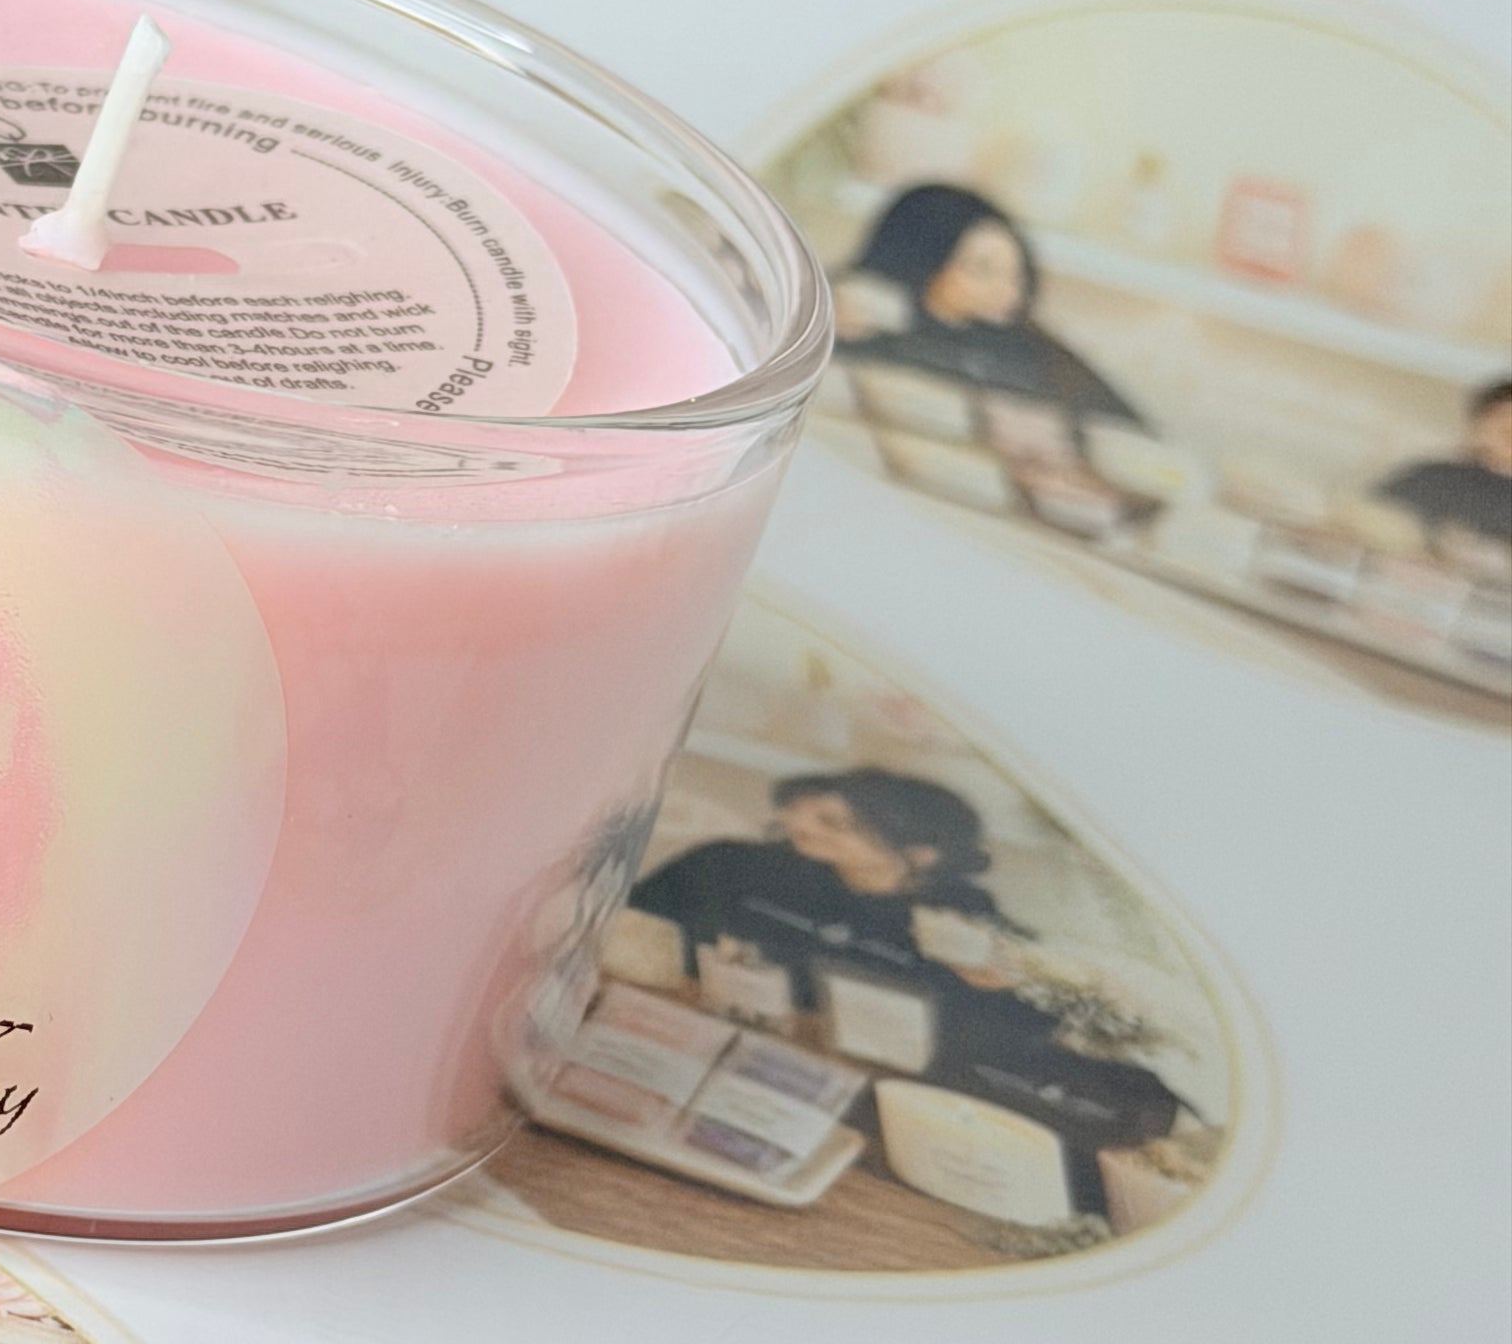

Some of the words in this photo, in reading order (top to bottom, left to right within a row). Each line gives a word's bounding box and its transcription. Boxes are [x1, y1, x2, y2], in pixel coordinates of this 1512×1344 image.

[139, 108, 281, 154] burning
[107, 201, 299, 228] CANDLE
[187, 96, 231, 115] fire
[238, 109, 290, 129] and
[292, 123, 383, 163] serious
[482, 237, 526, 291] candle
[510, 292, 537, 326] with
[46, 280, 73, 294] to
[160, 293, 240, 307] before
[243, 294, 301, 308] each
[231, 310, 331, 324] matches
[334, 307, 380, 322] and
[382, 302, 437, 317] wick
[138, 321, 163, 334] of
[165, 324, 203, 338] the
[329, 325, 368, 339] not
[108, 332, 171, 350] more
[169, 338, 227, 355] than
[337, 342, 360, 356] at
[130, 348, 157, 363] to
[160, 352, 208, 368] cool
[211, 356, 290, 373] before
[251, 375, 275, 389] of
[415, 354, 494, 414] Please
